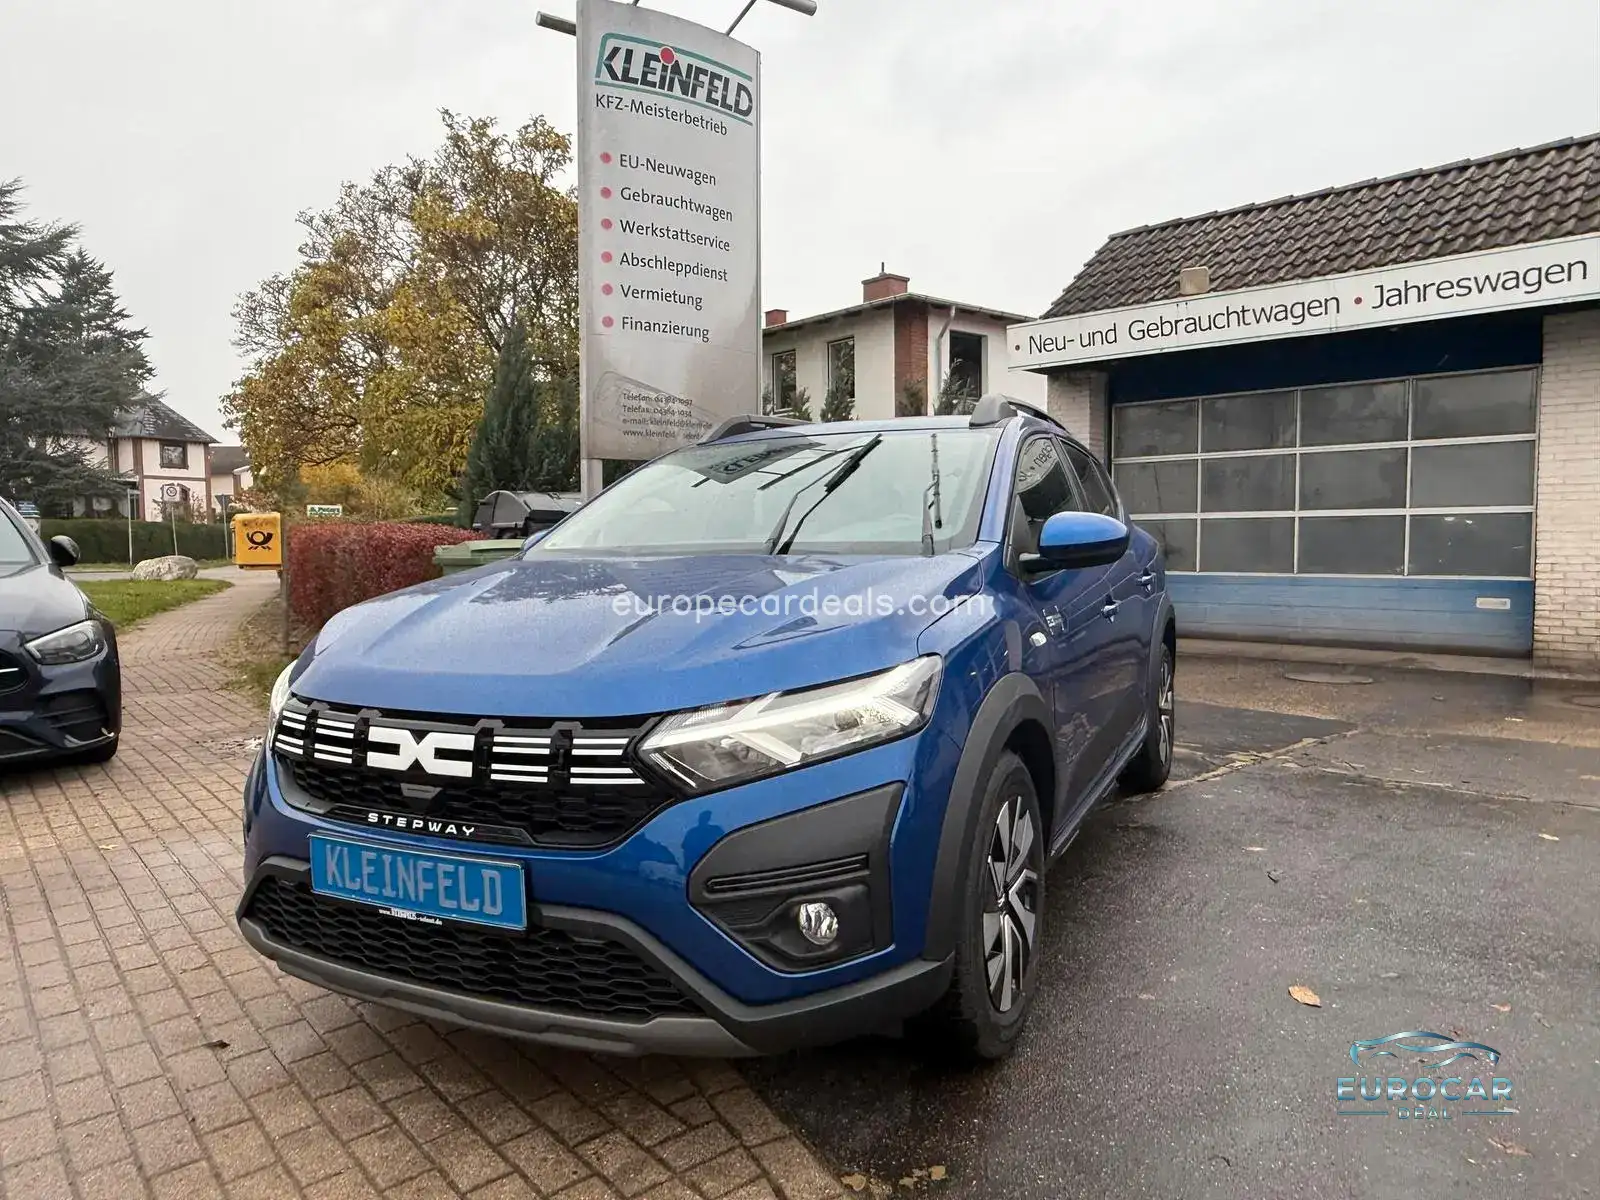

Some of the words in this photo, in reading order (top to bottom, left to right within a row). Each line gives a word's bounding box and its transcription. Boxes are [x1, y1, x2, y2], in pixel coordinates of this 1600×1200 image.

[596, 94, 728, 136] KFZ-Meisterbetrieb
[620, 154, 716, 186] EU-Neuwagen
[620, 187, 733, 222] Gebrauchtwagen
[620, 219, 730, 252] Werkstattservice
[620, 252, 728, 282] Abschleppdienst
[620, 284, 703, 311] Vermietung
[1079, 323, 1118, 348] und
[1128, 294, 1340, 341] Gebrauchtwagen
[1371, 259, 1588, 309] Jahreswagen
[621, 316, 710, 343] Finanzierung
[367, 812, 476, 837] STEPWAY
[325, 844, 504, 916] KLEINFELD
